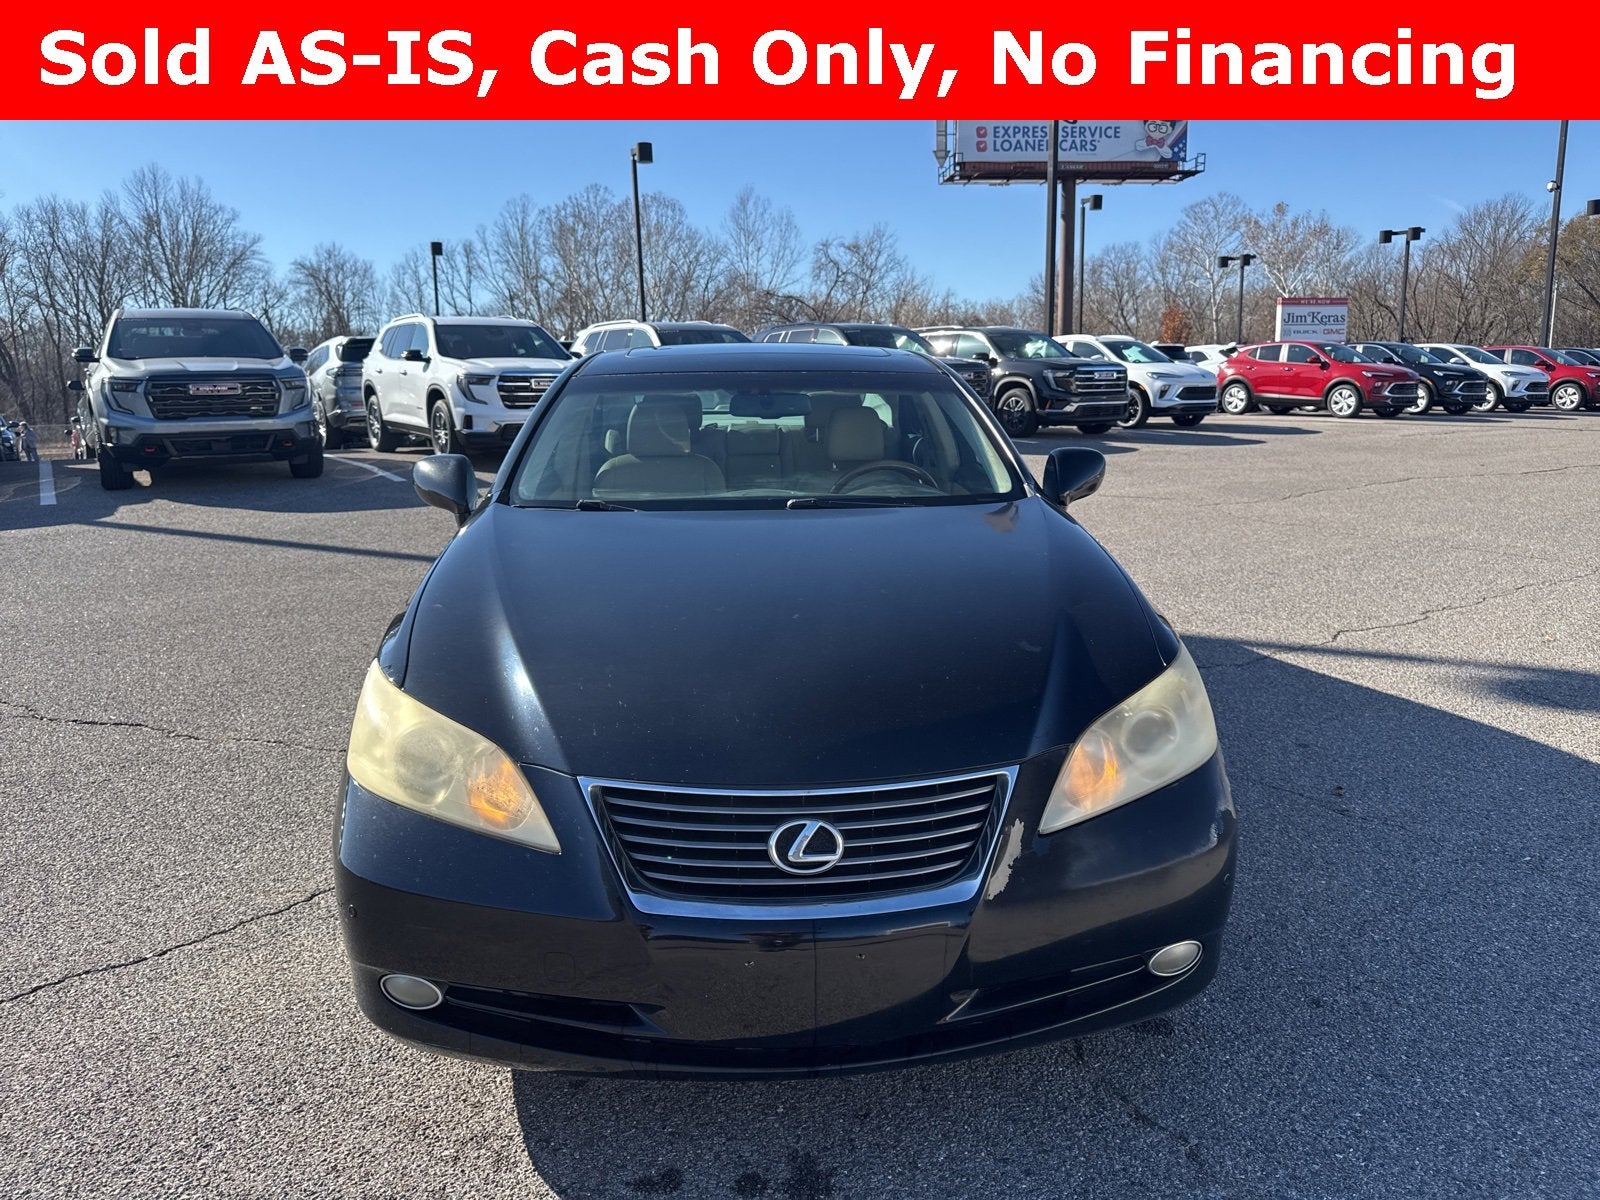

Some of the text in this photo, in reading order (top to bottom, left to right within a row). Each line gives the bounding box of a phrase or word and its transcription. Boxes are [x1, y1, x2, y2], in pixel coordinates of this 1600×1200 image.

[992, 126, 1120, 139] EXPRES SERVICE
[1283, 311, 1346, 326] Jim Keras
